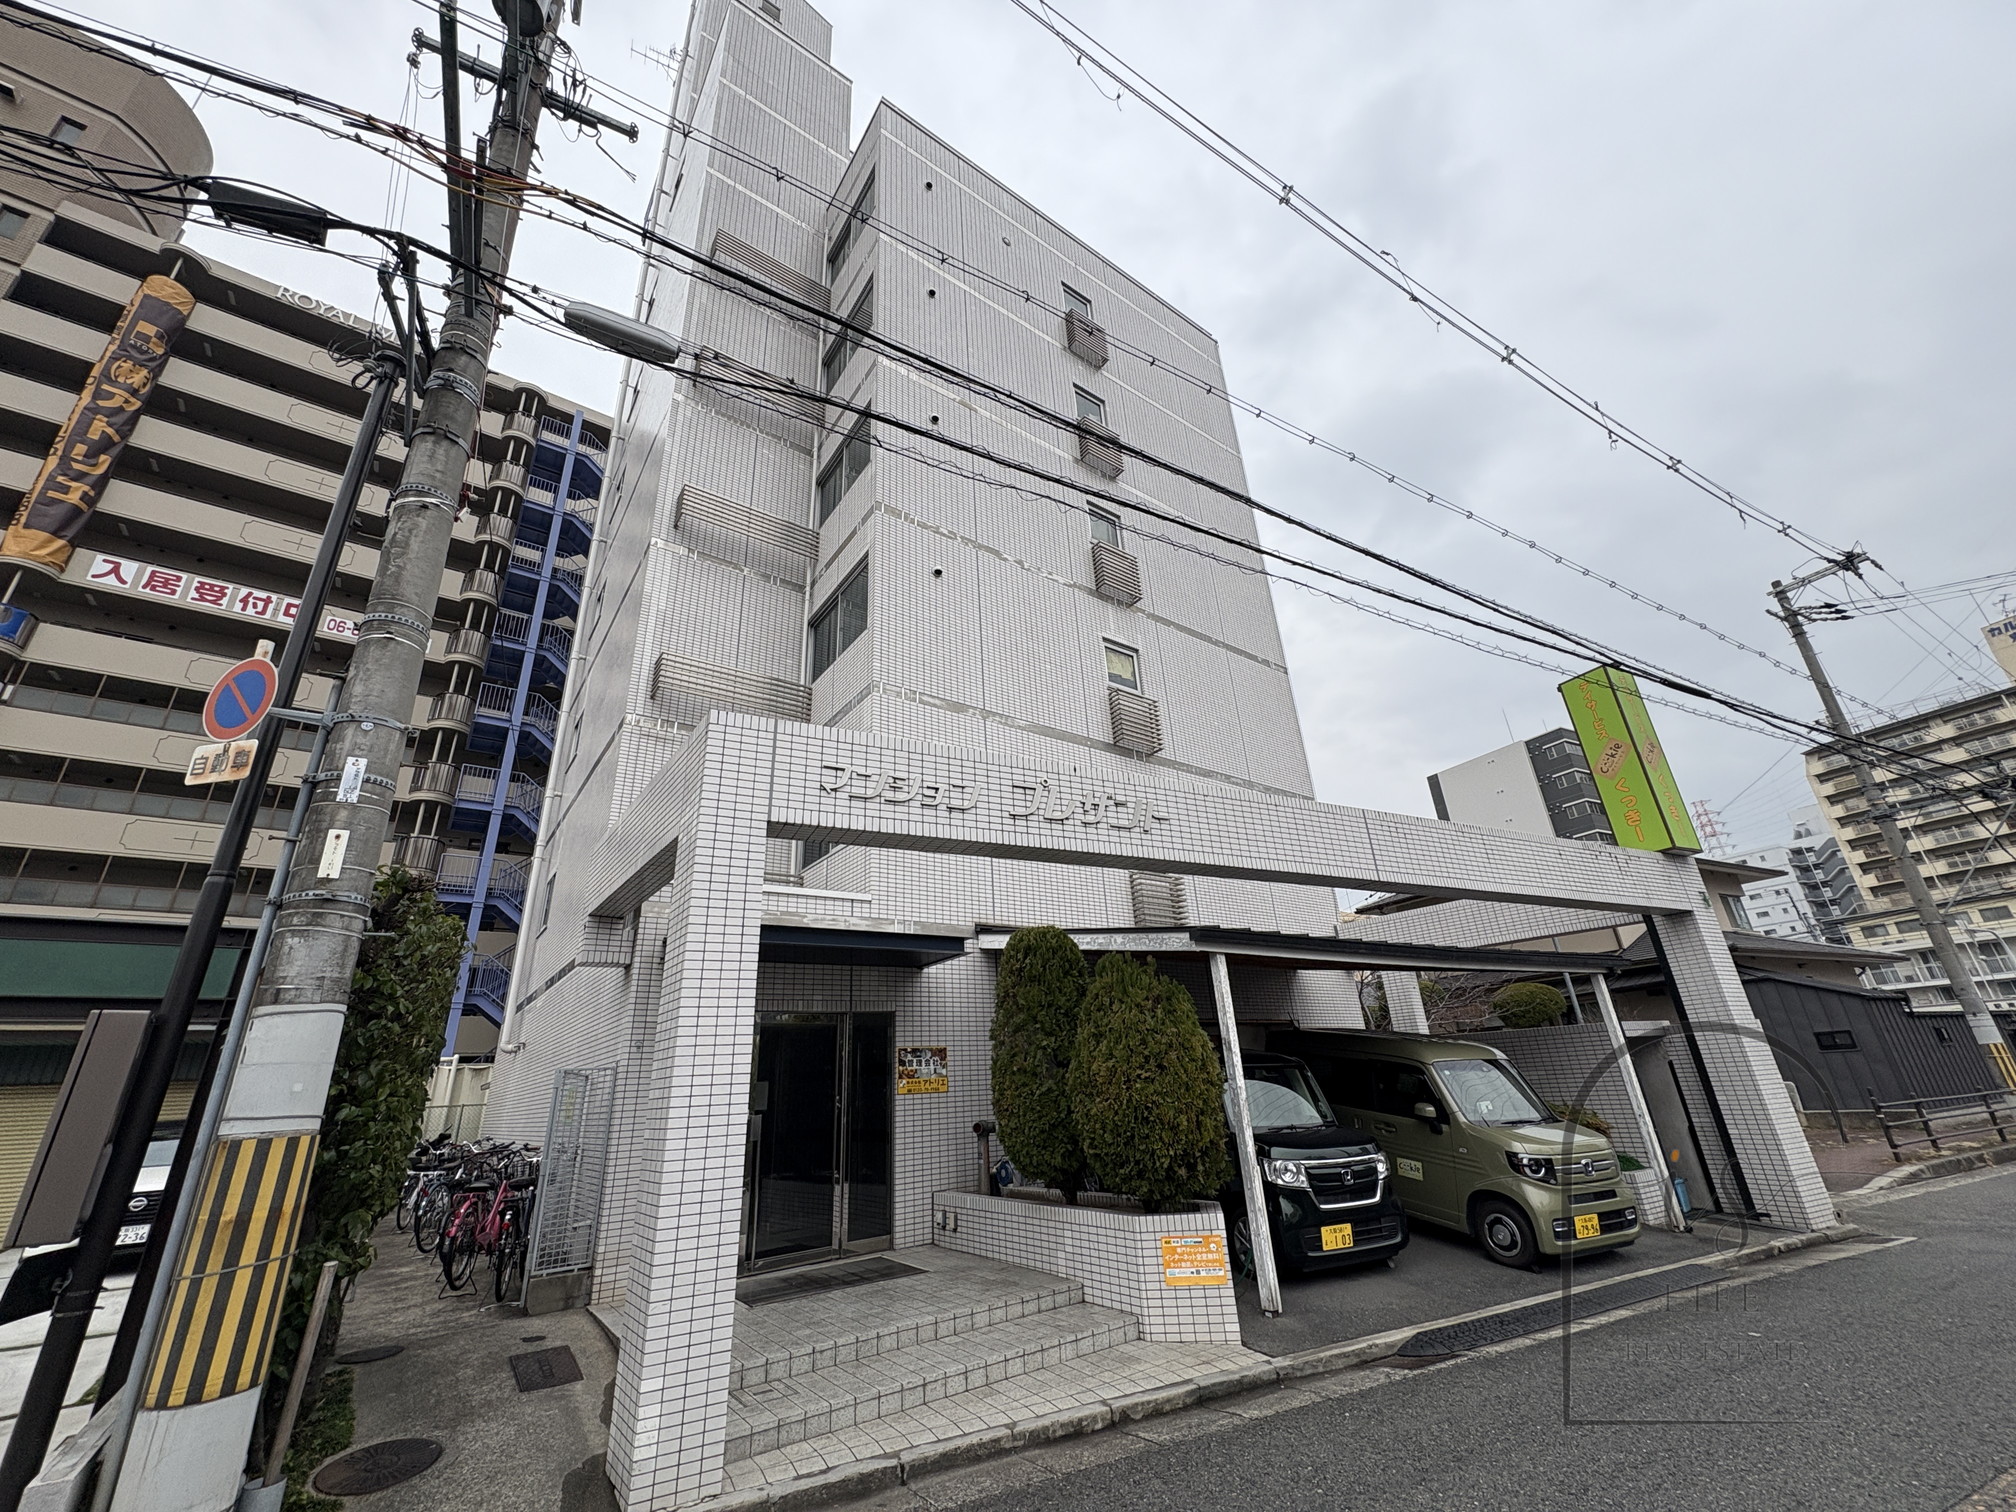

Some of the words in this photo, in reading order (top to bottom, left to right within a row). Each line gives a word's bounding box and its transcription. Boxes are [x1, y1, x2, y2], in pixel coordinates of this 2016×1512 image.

[276, 285, 360, 329] ROYAL
[190, 749, 251, 776] 自動車
[820, 763, 984, 812] マンション
[1009, 777, 1171, 833] プレザント
[906, 1057, 940, 1068] 管理会社
[922, 1078, 946, 1087] アトリエ
